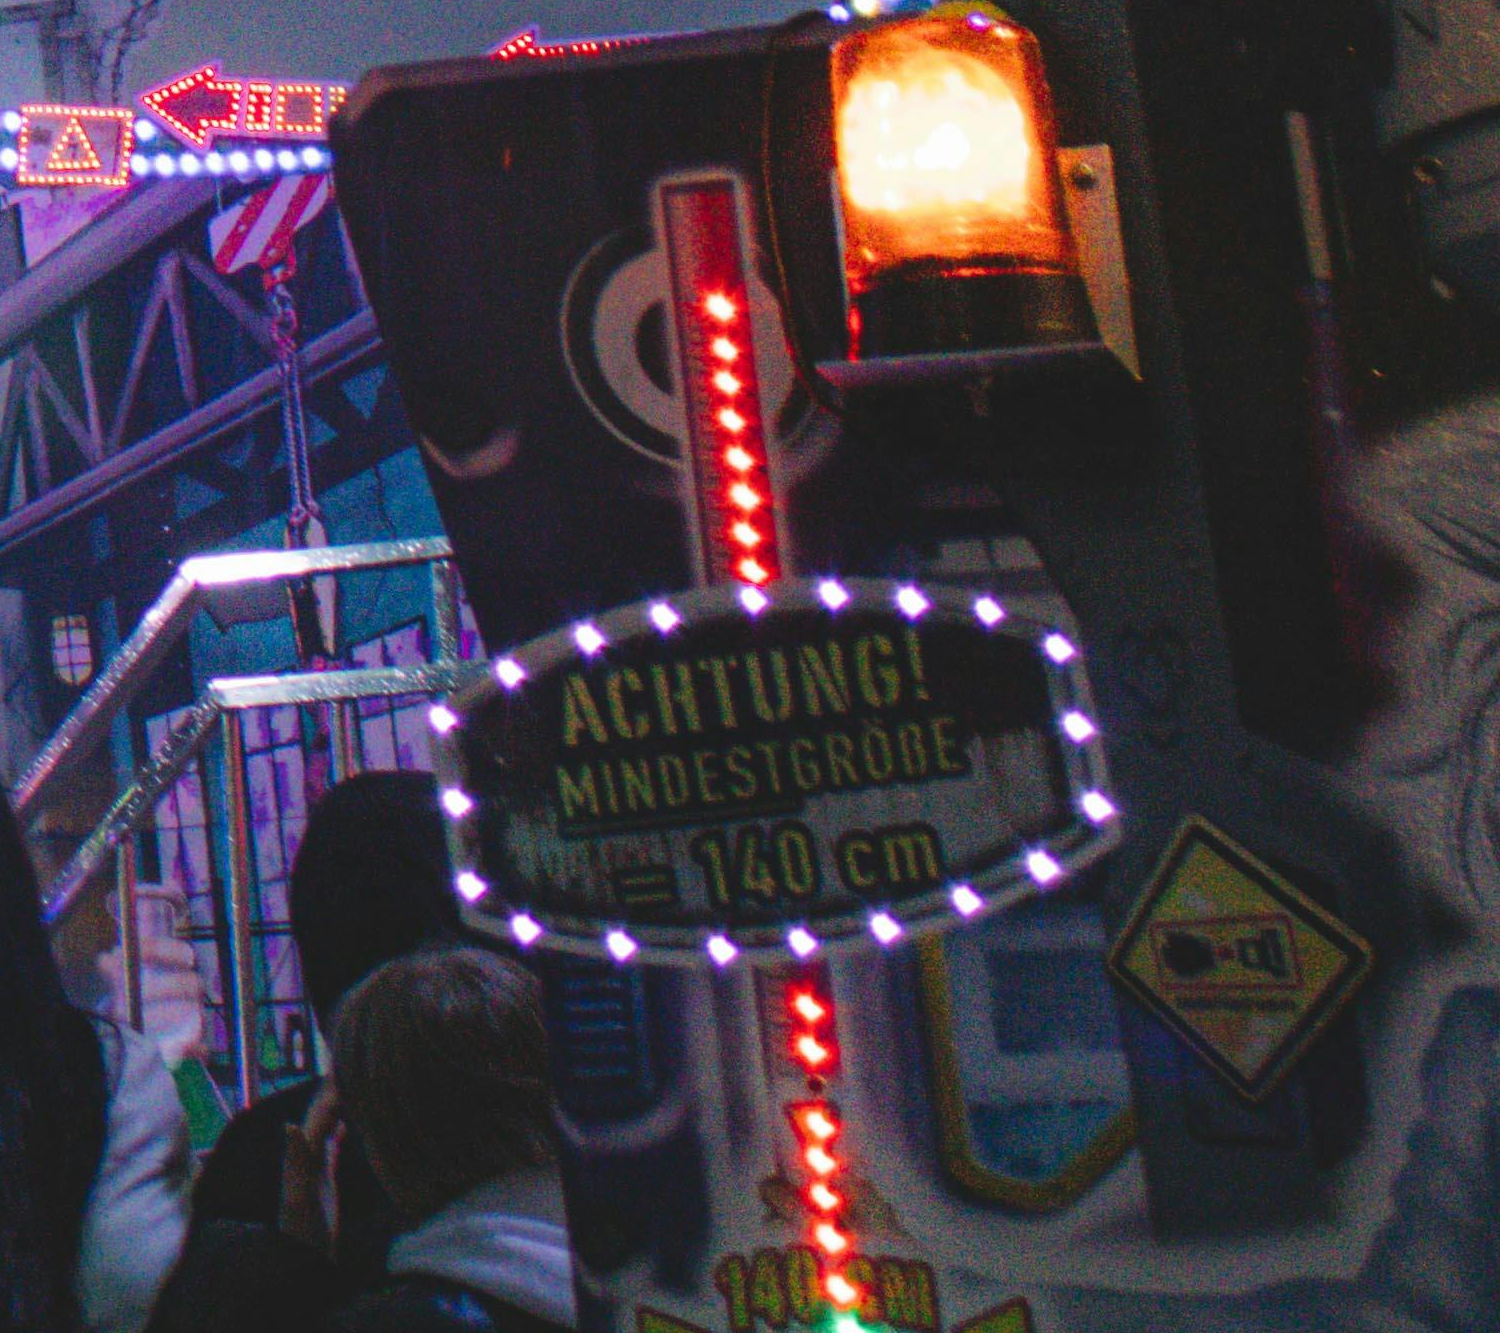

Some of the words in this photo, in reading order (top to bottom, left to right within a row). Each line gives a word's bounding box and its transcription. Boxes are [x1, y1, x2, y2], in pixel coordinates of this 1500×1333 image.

[561, 631, 931, 748] ACHTUNG!
[695, 829, 816, 905] 140
[842, 832, 941, 888] cm
